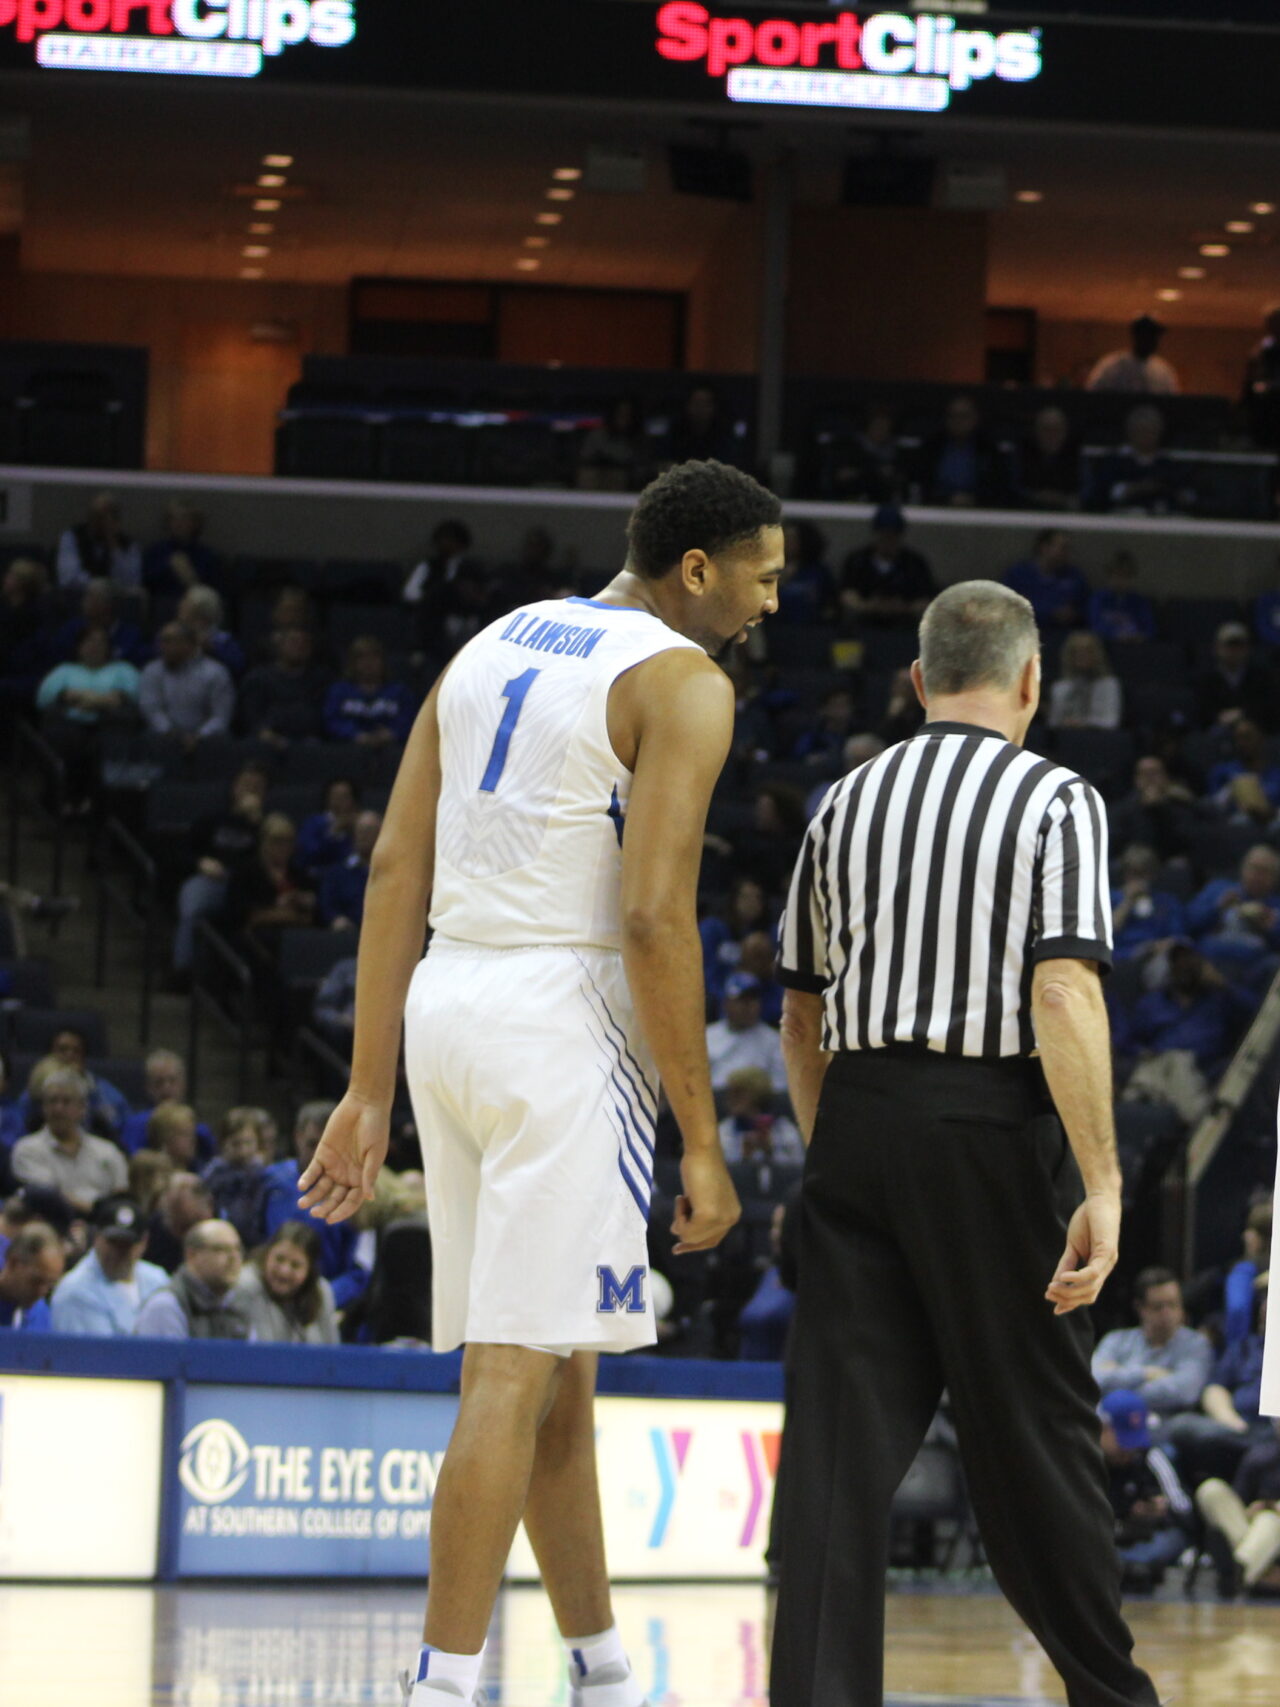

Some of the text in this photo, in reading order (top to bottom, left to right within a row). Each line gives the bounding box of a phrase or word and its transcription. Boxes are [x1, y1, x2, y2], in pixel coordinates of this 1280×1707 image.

[0, 0, 356, 55] portClips
[500, 612, 608, 659] D.LAWSON
[478, 667, 543, 793] 1
[596, 1264, 647, 1313] M
[253, 1445, 314, 1501] THE
[319, 1446, 375, 1503] EYE
[184, 1505, 208, 1536] AT
[210, 1505, 300, 1537] SOUTHERN
[302, 1507, 373, 1539] COLLEGE
[375, 1508, 399, 1540] OF
